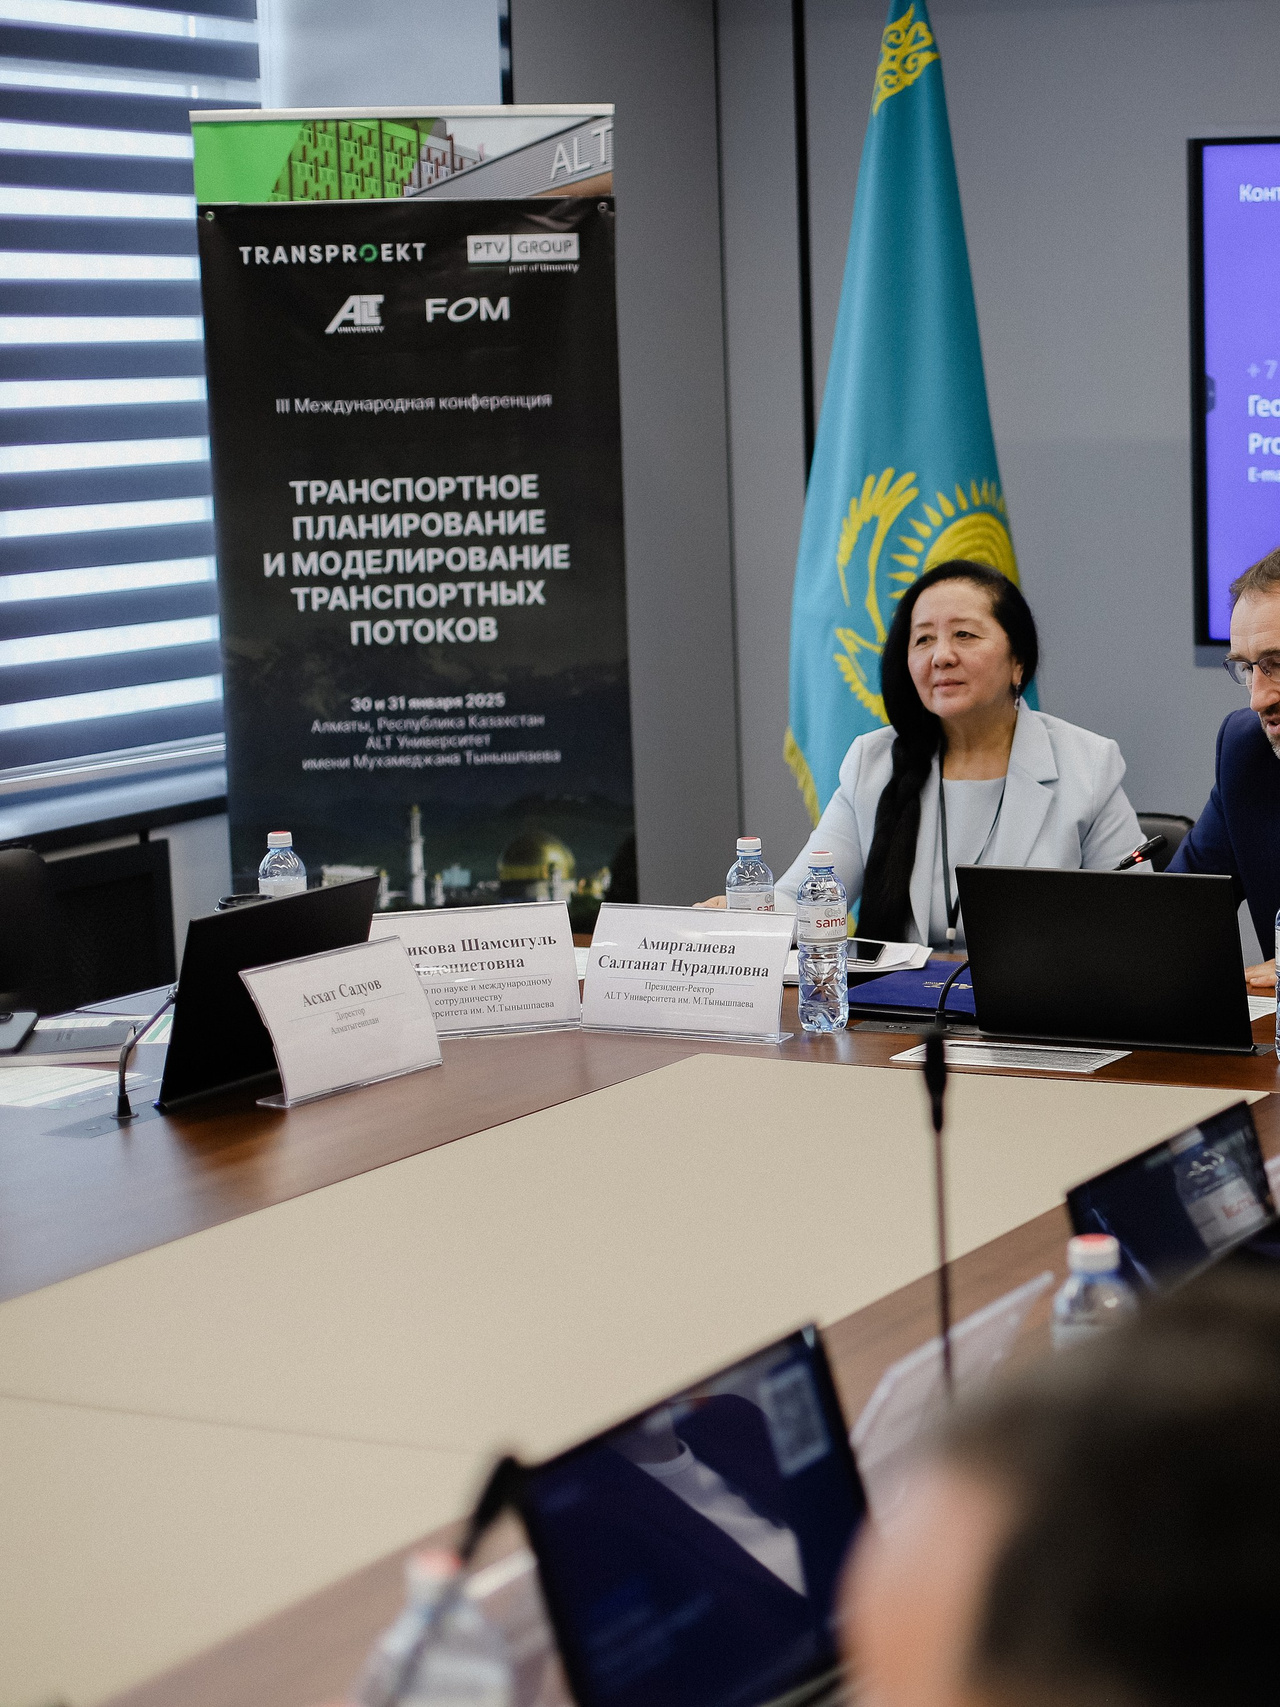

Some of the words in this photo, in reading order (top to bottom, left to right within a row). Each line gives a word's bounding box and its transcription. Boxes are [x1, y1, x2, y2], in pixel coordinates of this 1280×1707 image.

[550, 124, 612, 181] ALT
[239, 242, 427, 265] TRANSPROEKT
[473, 242, 505, 254] PTV
[517, 240, 572, 253] GROUP
[508, 265, 528, 275] part
[529, 264, 540, 273] of
[324, 294, 384, 334] ALT
[425, 296, 510, 322] FOM
[337, 325, 385, 334] UNIVERSITY
[1264, 360, 1278, 379] 7
[294, 396, 436, 415] Международная
[439, 394, 552, 412] конференция
[289, 474, 539, 505] ТРАНСПОРТНОЕ
[292, 509, 546, 541] ПЛАНИРОВАНИЕ
[263, 552, 286, 577] И
[292, 543, 570, 580] МОДЕЛИРОВАНИЕ
[290, 580, 546, 612] ТРАНСПОРТНЫХ
[350, 616, 498, 646] ПОТОКОВ
[351, 697, 372, 712] 30
[375, 699, 386, 711] и
[387, 695, 406, 711] 31
[408, 696, 464, 712] января
[465, 692, 506, 709] 2025
[311, 719, 375, 734] Алматы,
[377, 715, 466, 734] Республика
[468, 714, 545, 729] Казахстан
[365, 735, 392, 750] ALT
[396, 733, 491, 750] Университет
[302, 758, 350, 770] имени
[353, 753, 461, 771] Мухамеджана
[407, 943, 456, 956] икова
[461, 935, 557, 952] Шамсигуль
[637, 937, 736, 956] Амиргалиева
[598, 954, 667, 972] Салтанат
[671, 959, 769, 978] Нурадиловна
[302, 990, 336, 1007] Асхат
[338, 980, 382, 996] Садуов
[431, 987, 442, 995] по
[444, 985, 469, 995] науке
[479, 977, 553, 991] международному
[644, 981, 715, 994] Президент-Ректор
[435, 994, 503, 1008] сотрудничеству
[487, 1001, 555, 1013] М.Тынышпаева
[604, 992, 622, 1000] ALT
[623, 992, 676, 1004] Университета
[693, 997, 754, 1008] М.Тынышпаева
[335, 1008, 366, 1021] Директор
